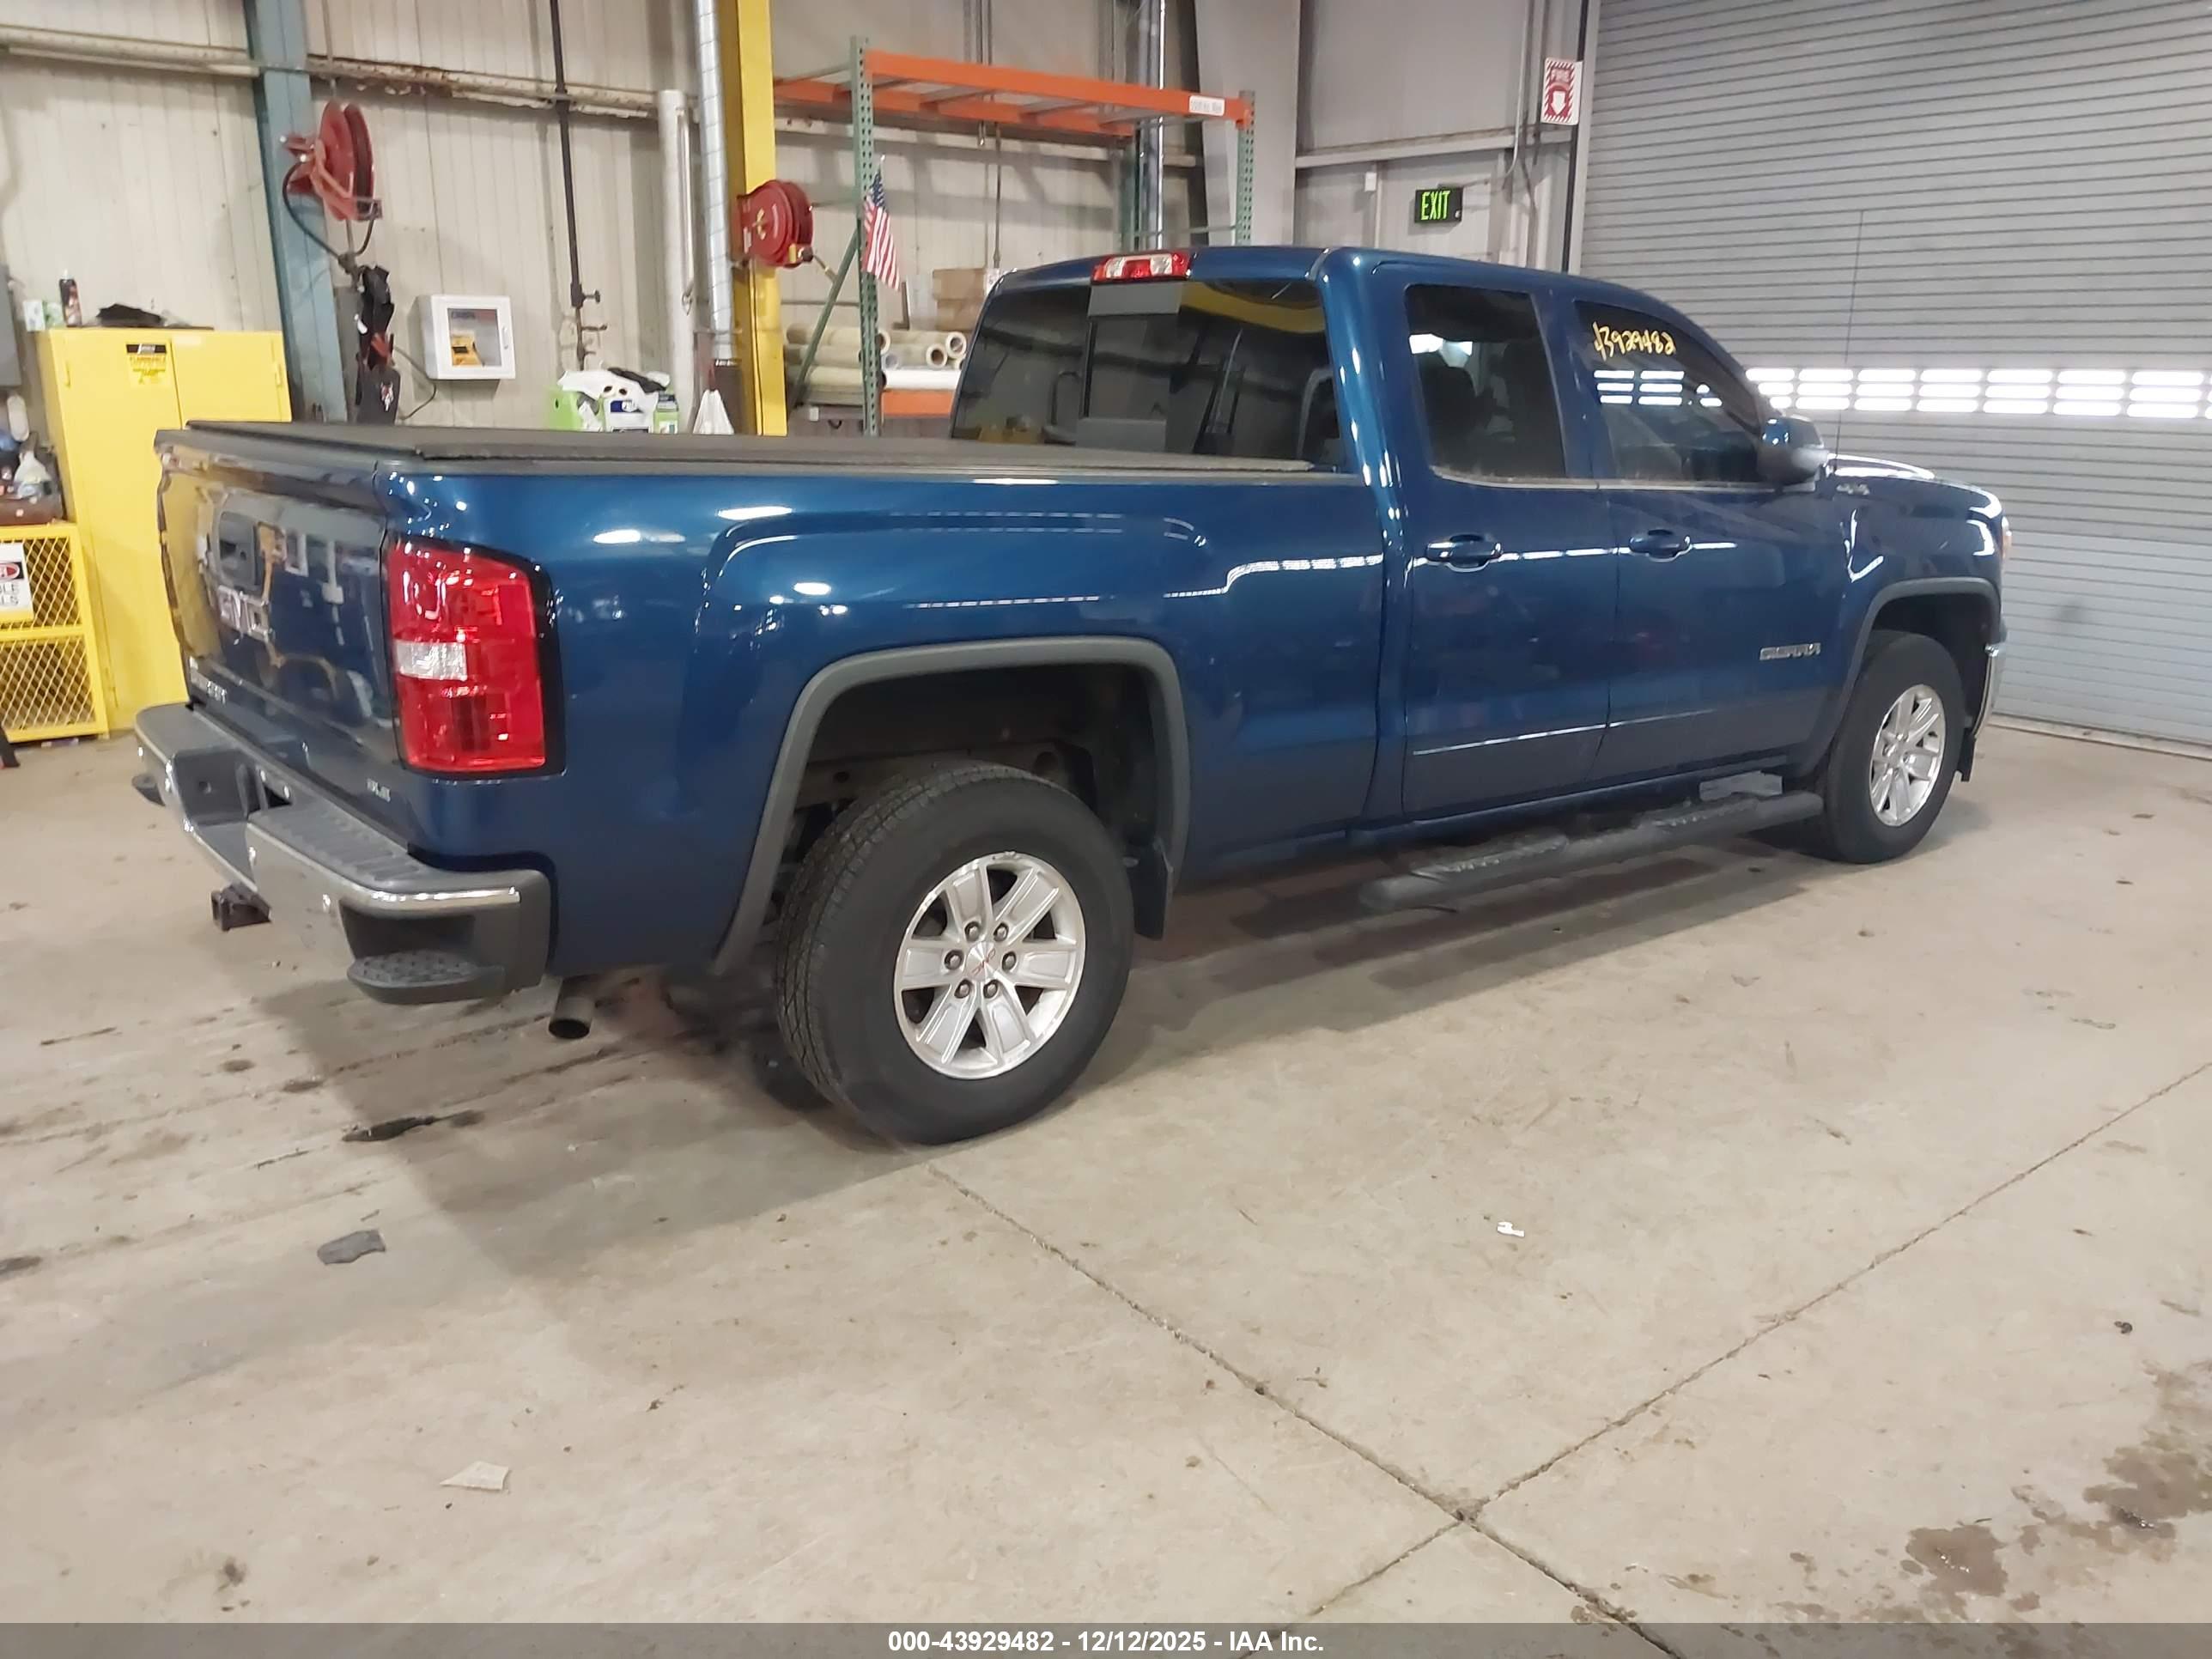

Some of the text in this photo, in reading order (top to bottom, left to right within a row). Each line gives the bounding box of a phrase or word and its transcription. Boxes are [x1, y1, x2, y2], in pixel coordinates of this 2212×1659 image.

[1551, 69, 1571, 82] FIRE
[1421, 190, 1451, 221] EXIT
[1593, 321, 1676, 362] 43929482
